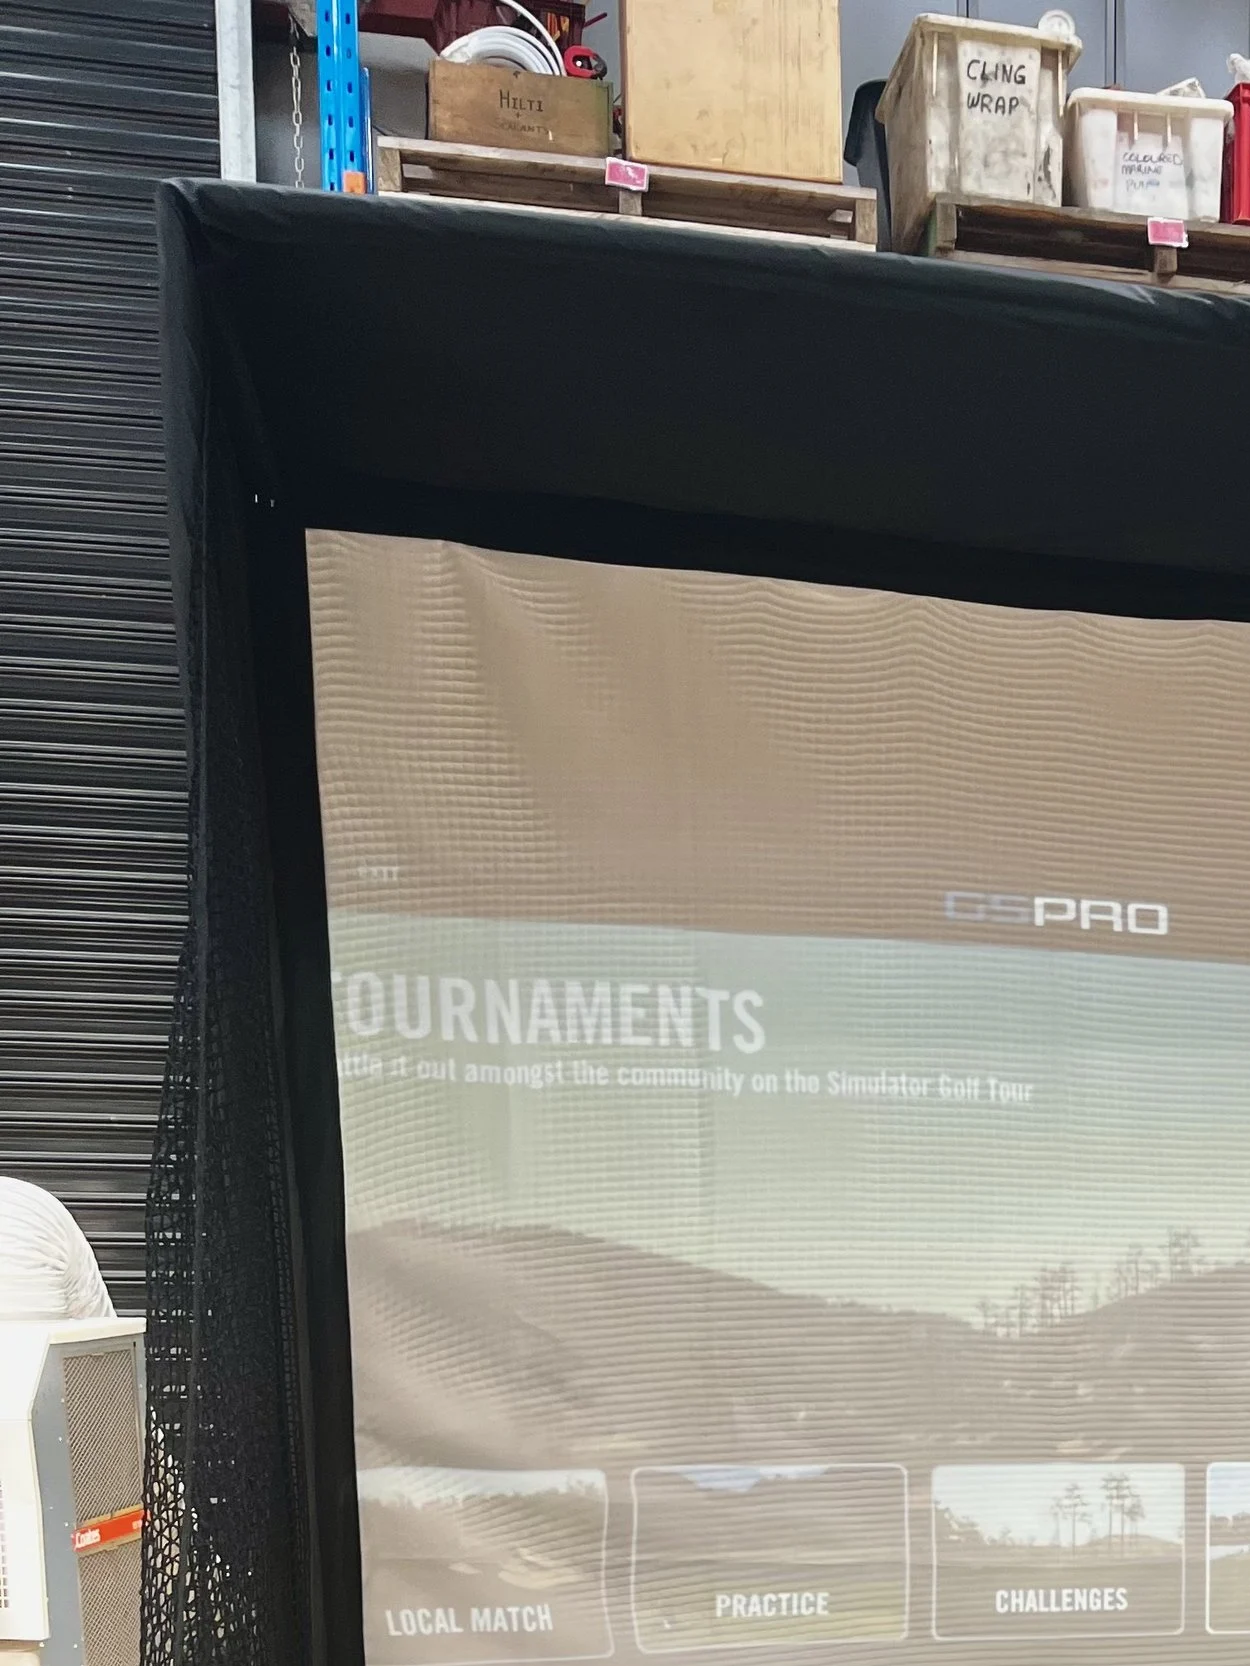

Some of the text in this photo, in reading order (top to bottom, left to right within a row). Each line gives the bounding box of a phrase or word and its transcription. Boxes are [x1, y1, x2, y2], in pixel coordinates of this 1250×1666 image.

[966, 59, 1026, 85] CLING
[499, 89, 544, 113] HILTI
[967, 91, 1020, 116] WRAP
[944, 890, 1168, 936] GSPRO
[333, 970, 766, 1055] OURNAMENTS
[417, 1057, 456, 1082] out
[464, 1060, 563, 1089] amongst
[574, 1060, 609, 1086] the
[618, 1065, 745, 1097] community
[751, 1072, 778, 1094] on
[785, 1068, 820, 1094] the
[827, 1070, 929, 1097] Simulator
[938, 1073, 981, 1100] Golf
[987, 1077, 1034, 1103] Tour
[714, 1592, 830, 1619] PRACTICE
[994, 1587, 1129, 1615] CHALLENGES
[385, 1603, 554, 1637] LOCAL MATCH
